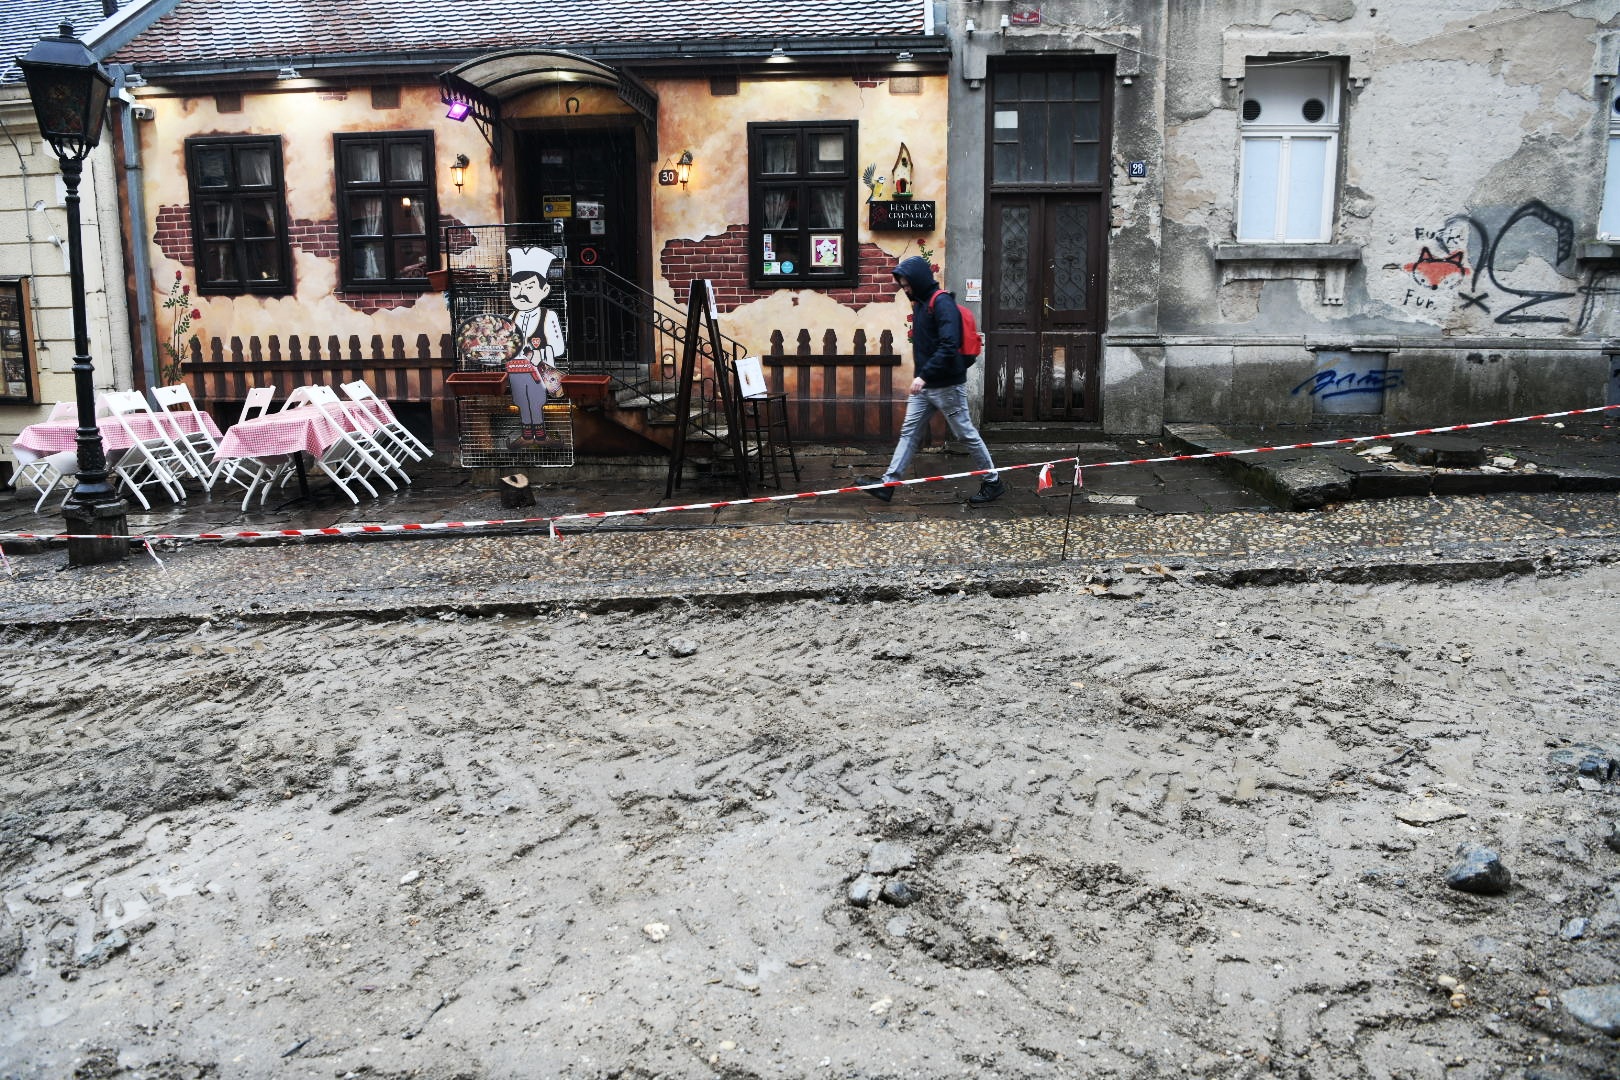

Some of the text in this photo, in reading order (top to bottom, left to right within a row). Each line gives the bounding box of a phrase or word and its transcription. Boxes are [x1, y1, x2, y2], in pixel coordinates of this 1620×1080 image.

[1132, 163, 1143, 175] 28
[662, 171, 674, 182] 30
[890, 203, 933, 211] RESTORAN
